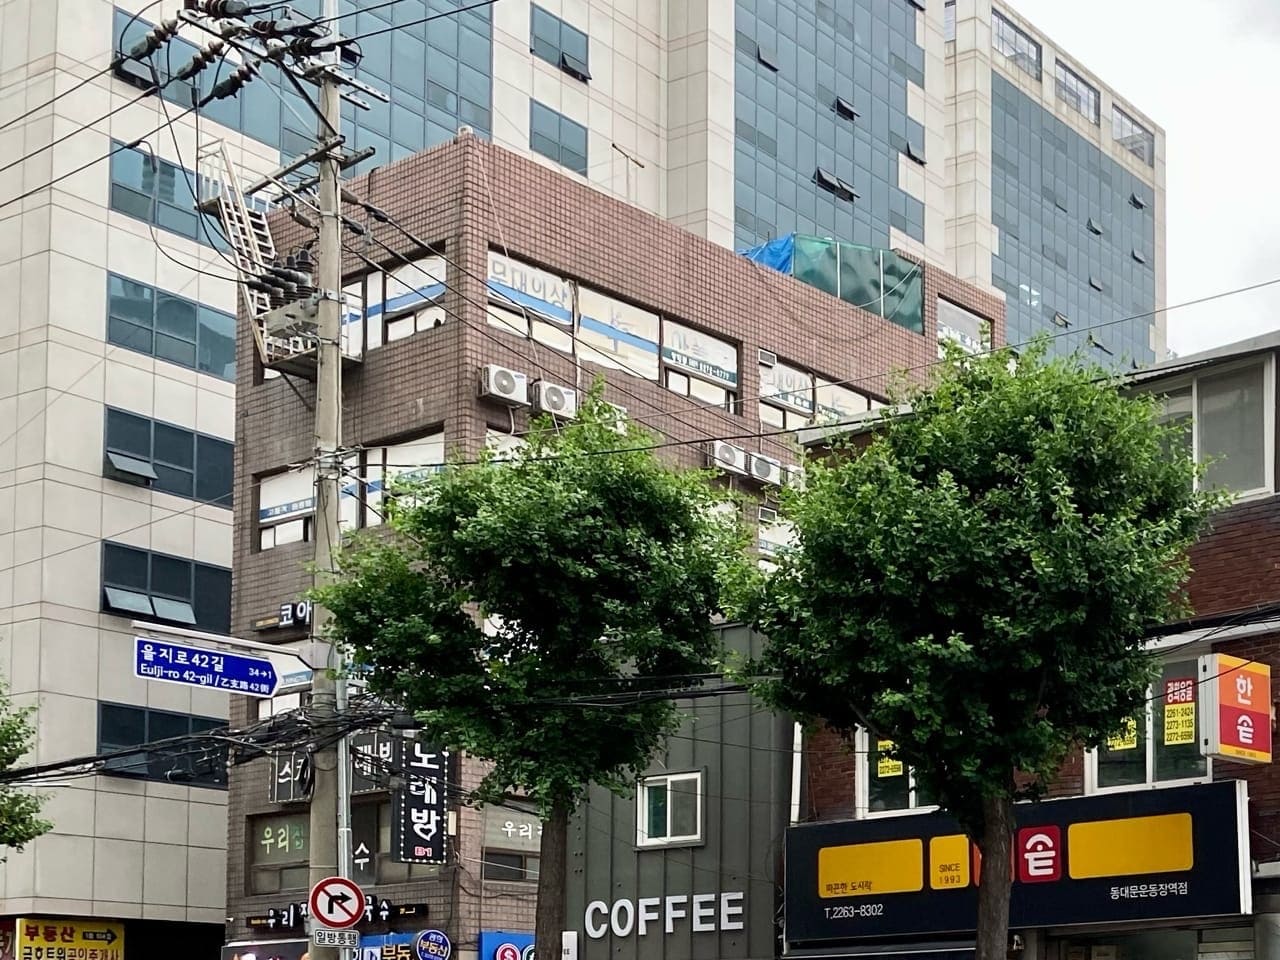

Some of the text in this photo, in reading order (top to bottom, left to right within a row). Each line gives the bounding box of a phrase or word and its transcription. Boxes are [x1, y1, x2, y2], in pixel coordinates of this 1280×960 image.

[141, 644, 225, 674] 을지로42길
[140, 663, 180, 680] Eulji-ro
[183, 670, 213, 686] 42-gil
[409, 743, 441, 842] 노래방
[939, 862, 961, 873] SINCE
[850, 881, 873, 892] 도시락
[939, 874, 961, 884] 1993
[1109, 881, 1188, 900] 동대문운동장역점
[584, 891, 744, 939] COFFEE
[824, 903, 884, 920] T.2263-8302
[24, 924, 76, 943] 부동산
[316, 931, 357, 945] 일방통행
[420, 939, 448, 958] 부동산
